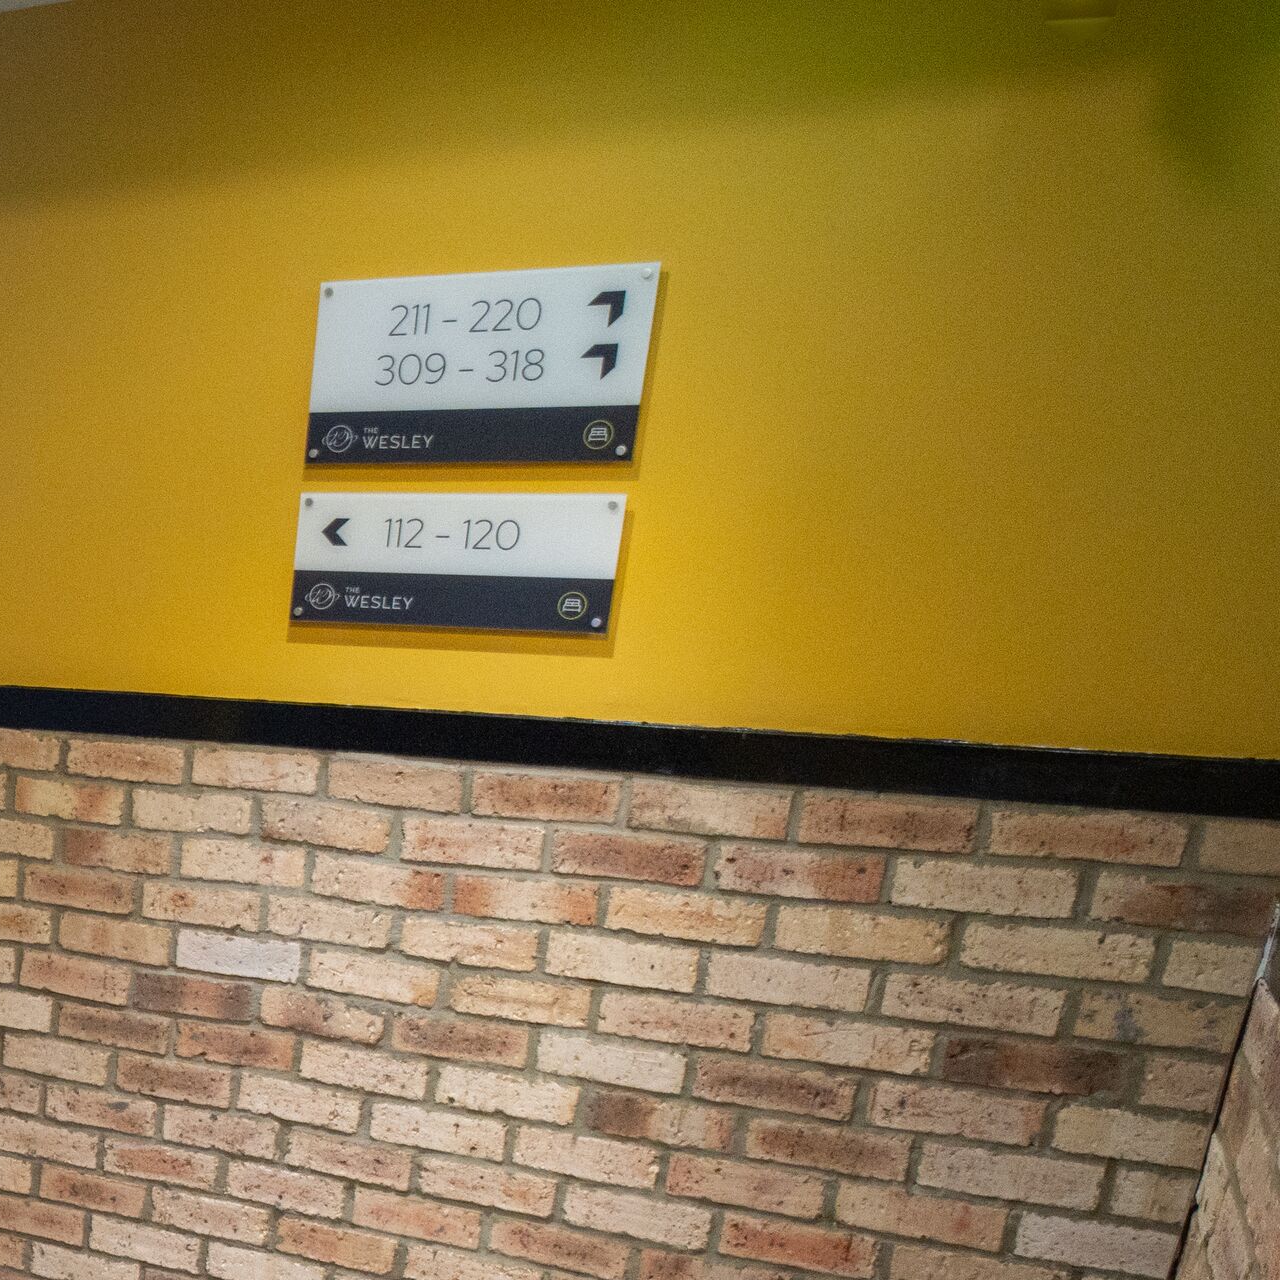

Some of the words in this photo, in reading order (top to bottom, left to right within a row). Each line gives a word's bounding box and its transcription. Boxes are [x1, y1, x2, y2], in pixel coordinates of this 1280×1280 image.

[388, 303, 431, 337] 211
[469, 298, 542, 333] 220
[374, 352, 446, 386] 309
[486, 349, 545, 383] 318
[362, 435, 434, 449] WESLEY
[384, 518, 425, 549] 112
[462, 519, 521, 551] 120
[344, 595, 413, 610] WESLEY
